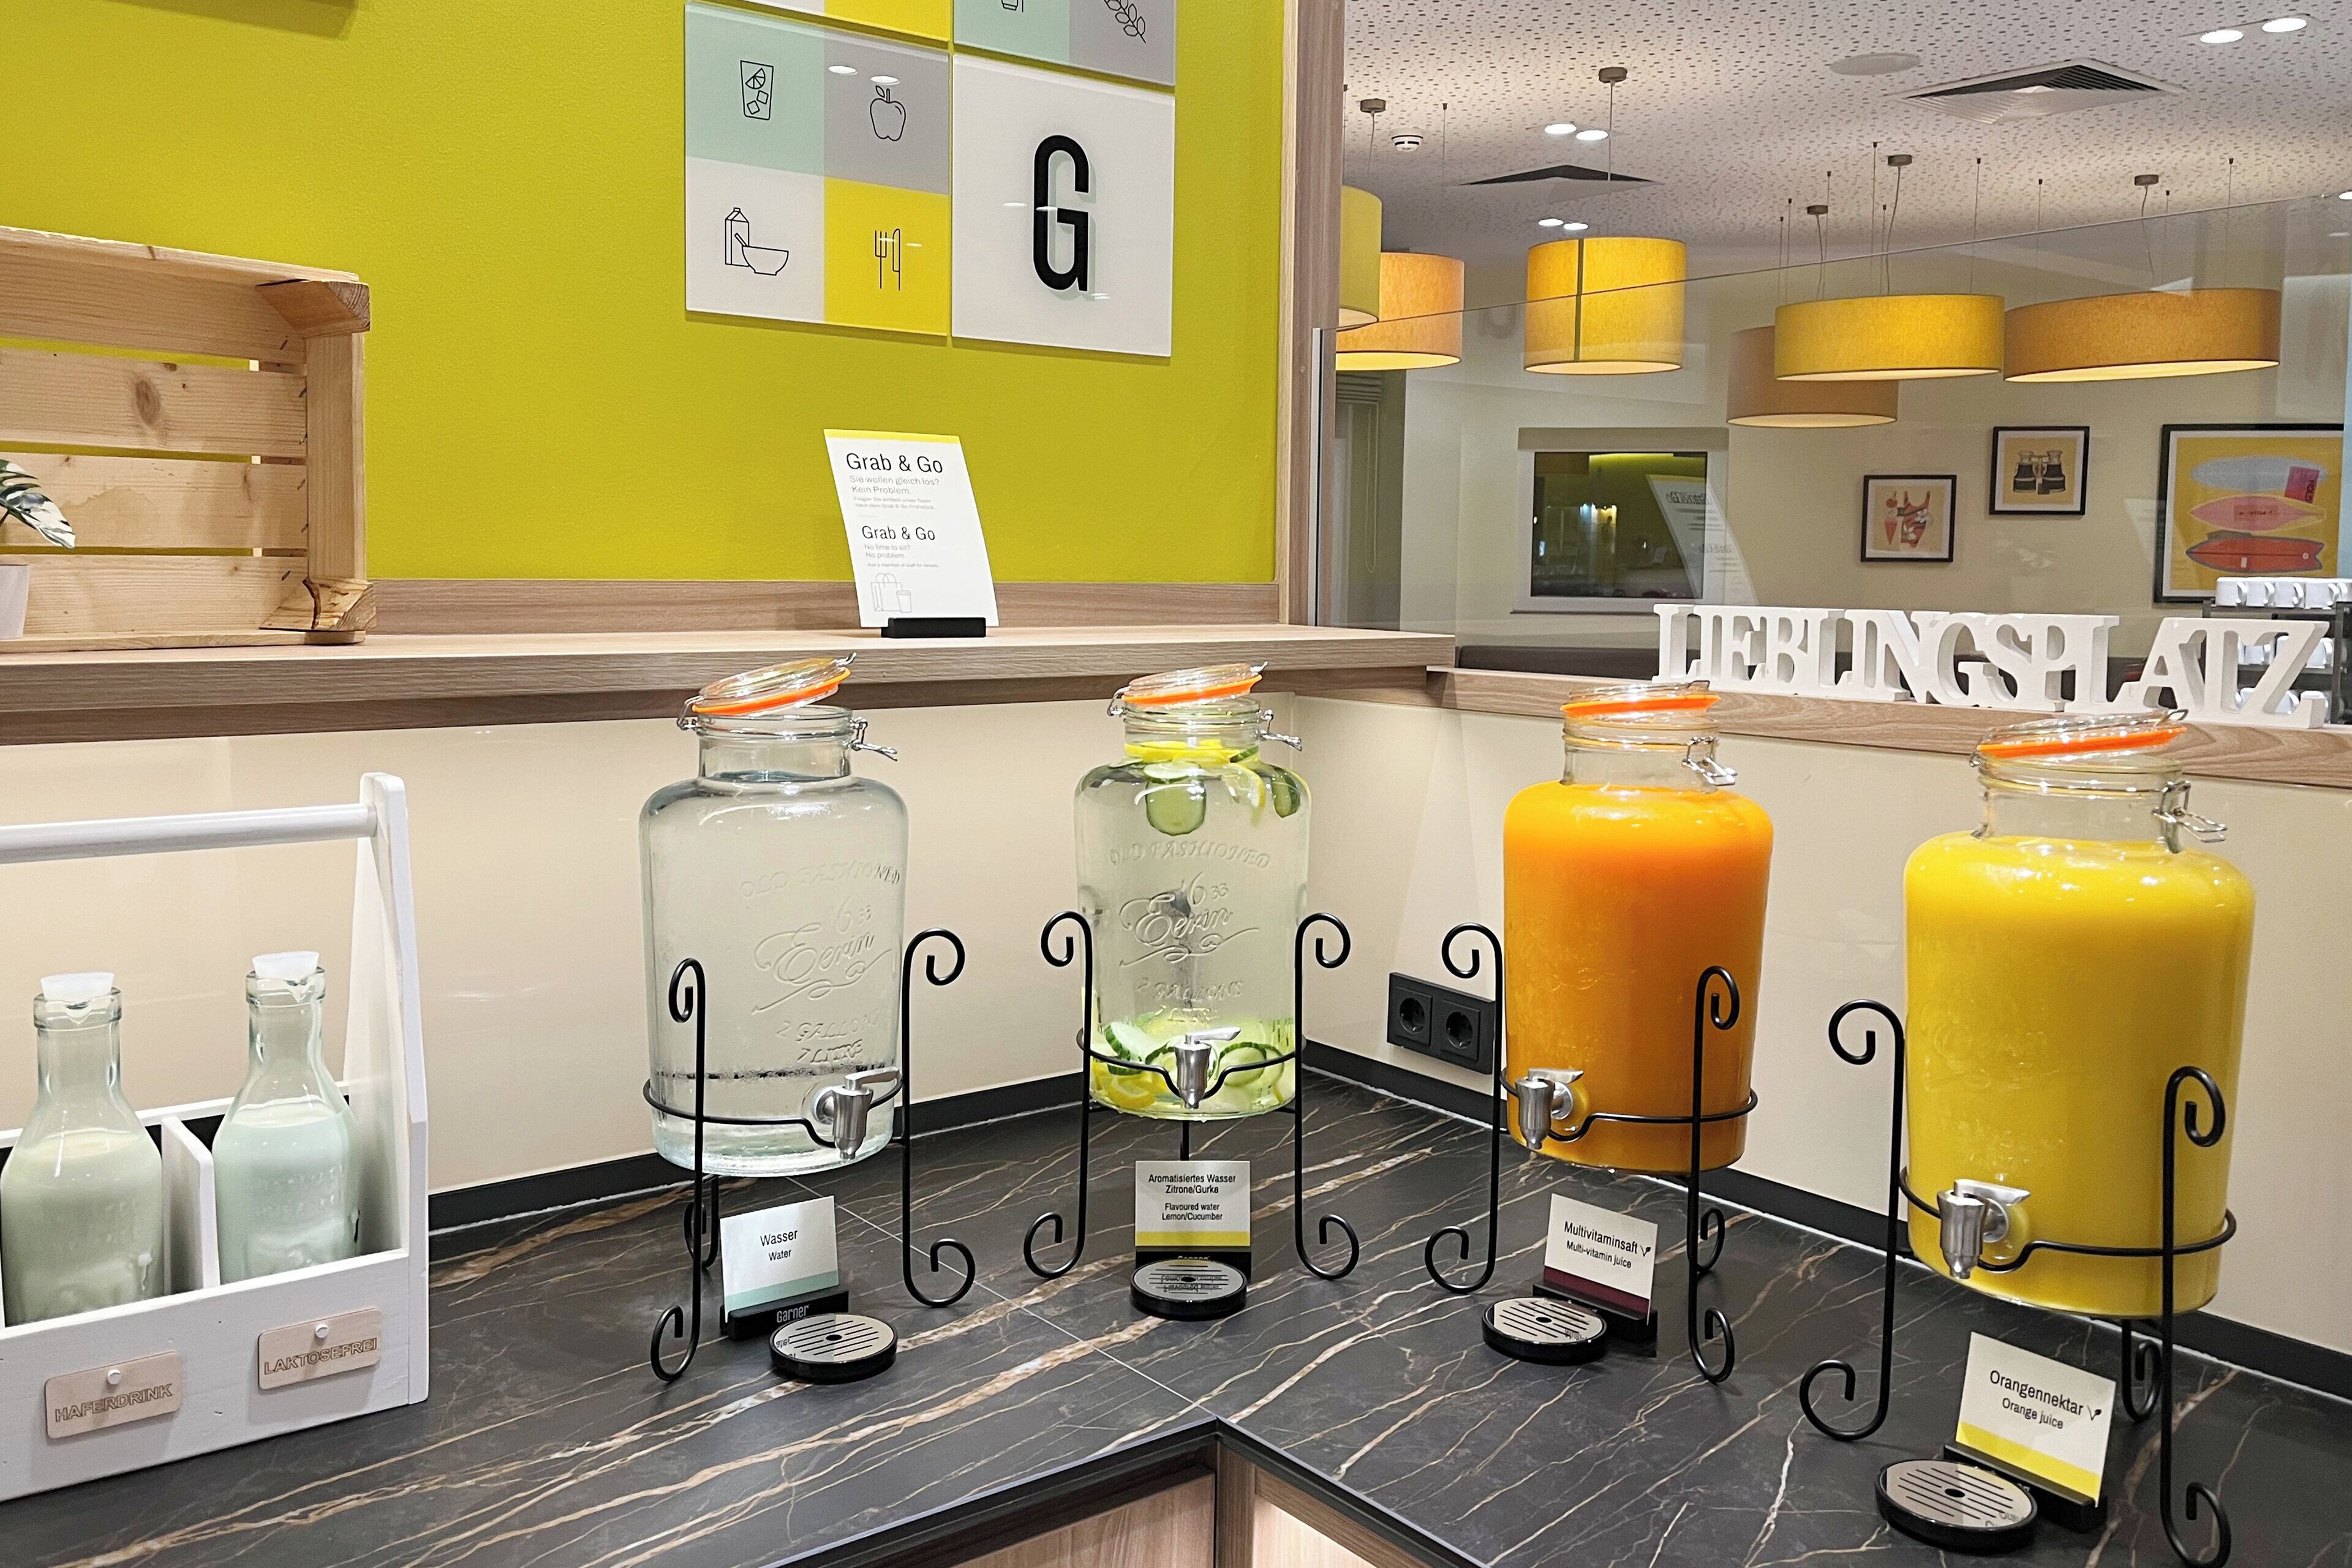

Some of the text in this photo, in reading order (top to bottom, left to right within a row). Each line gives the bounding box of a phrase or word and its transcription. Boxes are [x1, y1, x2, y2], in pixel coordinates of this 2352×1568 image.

[1033, 134, 1091, 293] G
[846, 453, 943, 473] Grab & Go
[849, 475, 864, 483] Sie
[895, 477, 920, 486] gleich
[862, 526, 935, 540] Grab & Go
[1652, 603, 2331, 729] LIEBLINGSPLATZ
[1148, 1174, 1236, 1183] Aromatisiertes Wasser
[1165, 1184, 1219, 1194] Zitrone/Gurke
[1161, 1212, 1223, 1221] Lemon/Cucumber
[1164, 1202, 1199, 1211] Flavoured
[760, 1229, 798, 1246] Wasser
[1564, 1220, 1638, 1254] Multivitaminsaft
[768, 1249, 792, 1261] Water
[1566, 1240, 1632, 1269] Multi-vitamin juice
[776, 1304, 809, 1324] Garner
[263, 1338, 378, 1376] LAKTOSEFREI
[54, 1382, 174, 1423] HAFERDRINK
[1989, 1370, 2084, 1416] Orangennektar
[2002, 1397, 2064, 1430] Orange juice
